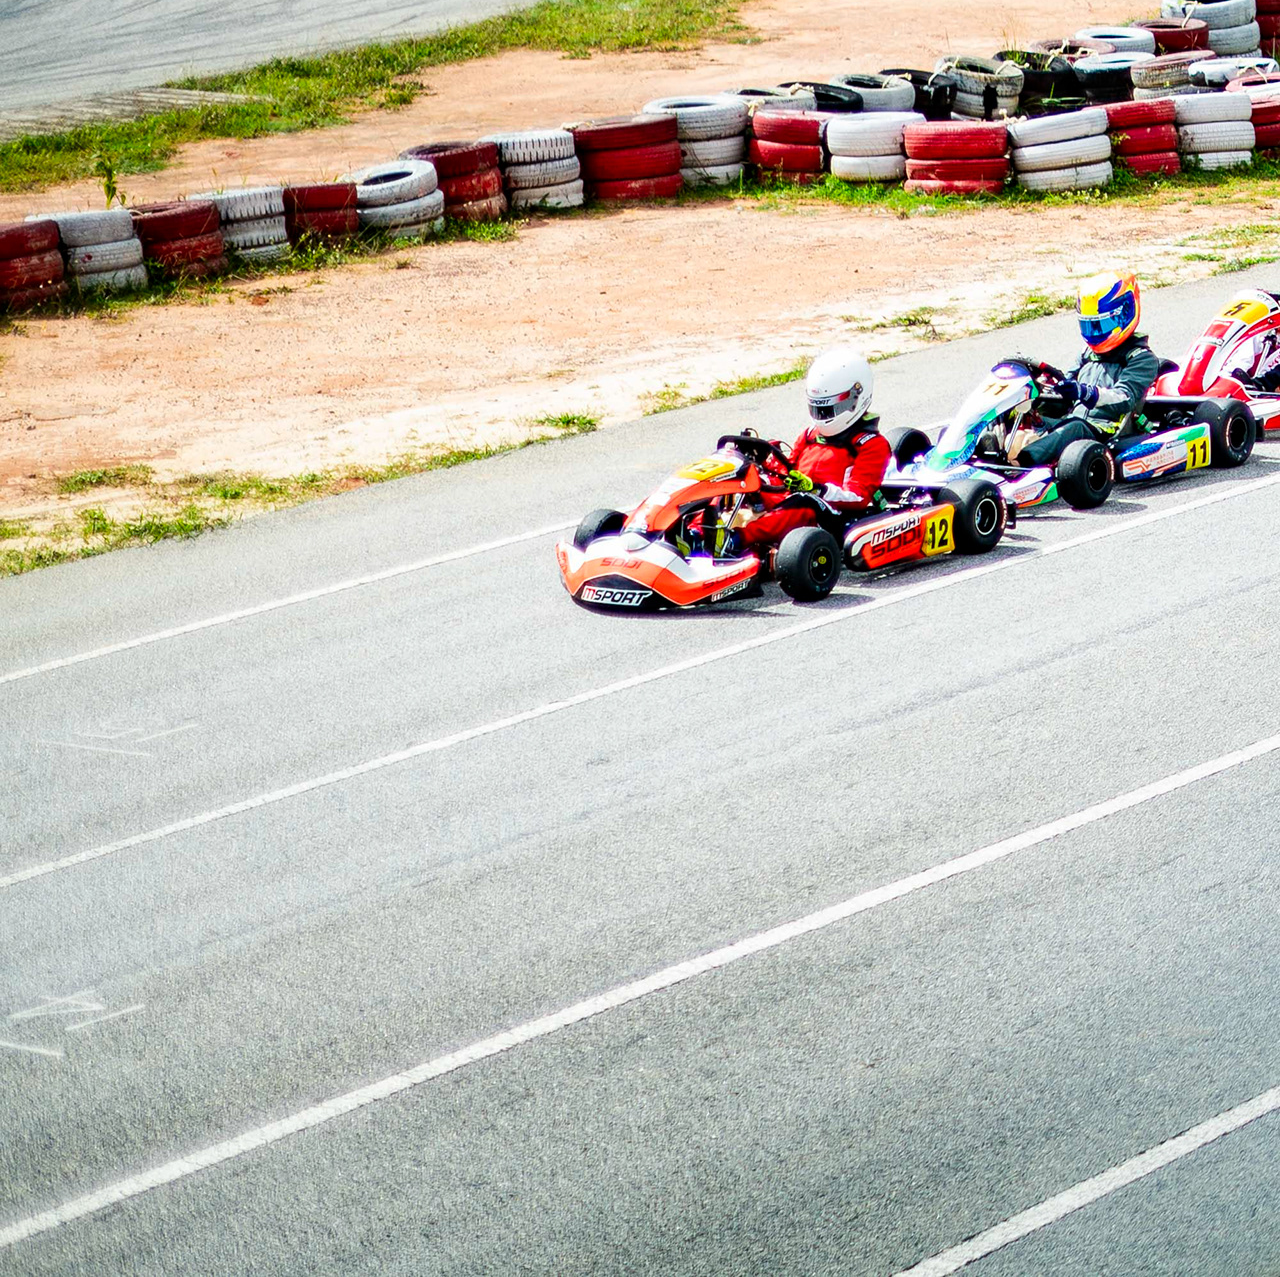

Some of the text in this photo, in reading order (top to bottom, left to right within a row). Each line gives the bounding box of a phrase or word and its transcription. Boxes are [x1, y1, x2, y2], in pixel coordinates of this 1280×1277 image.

[1223, 302, 1252, 316] 5
[983, 383, 1009, 396] 11
[1190, 440, 1207, 467] 11
[929, 518, 949, 550] 12
